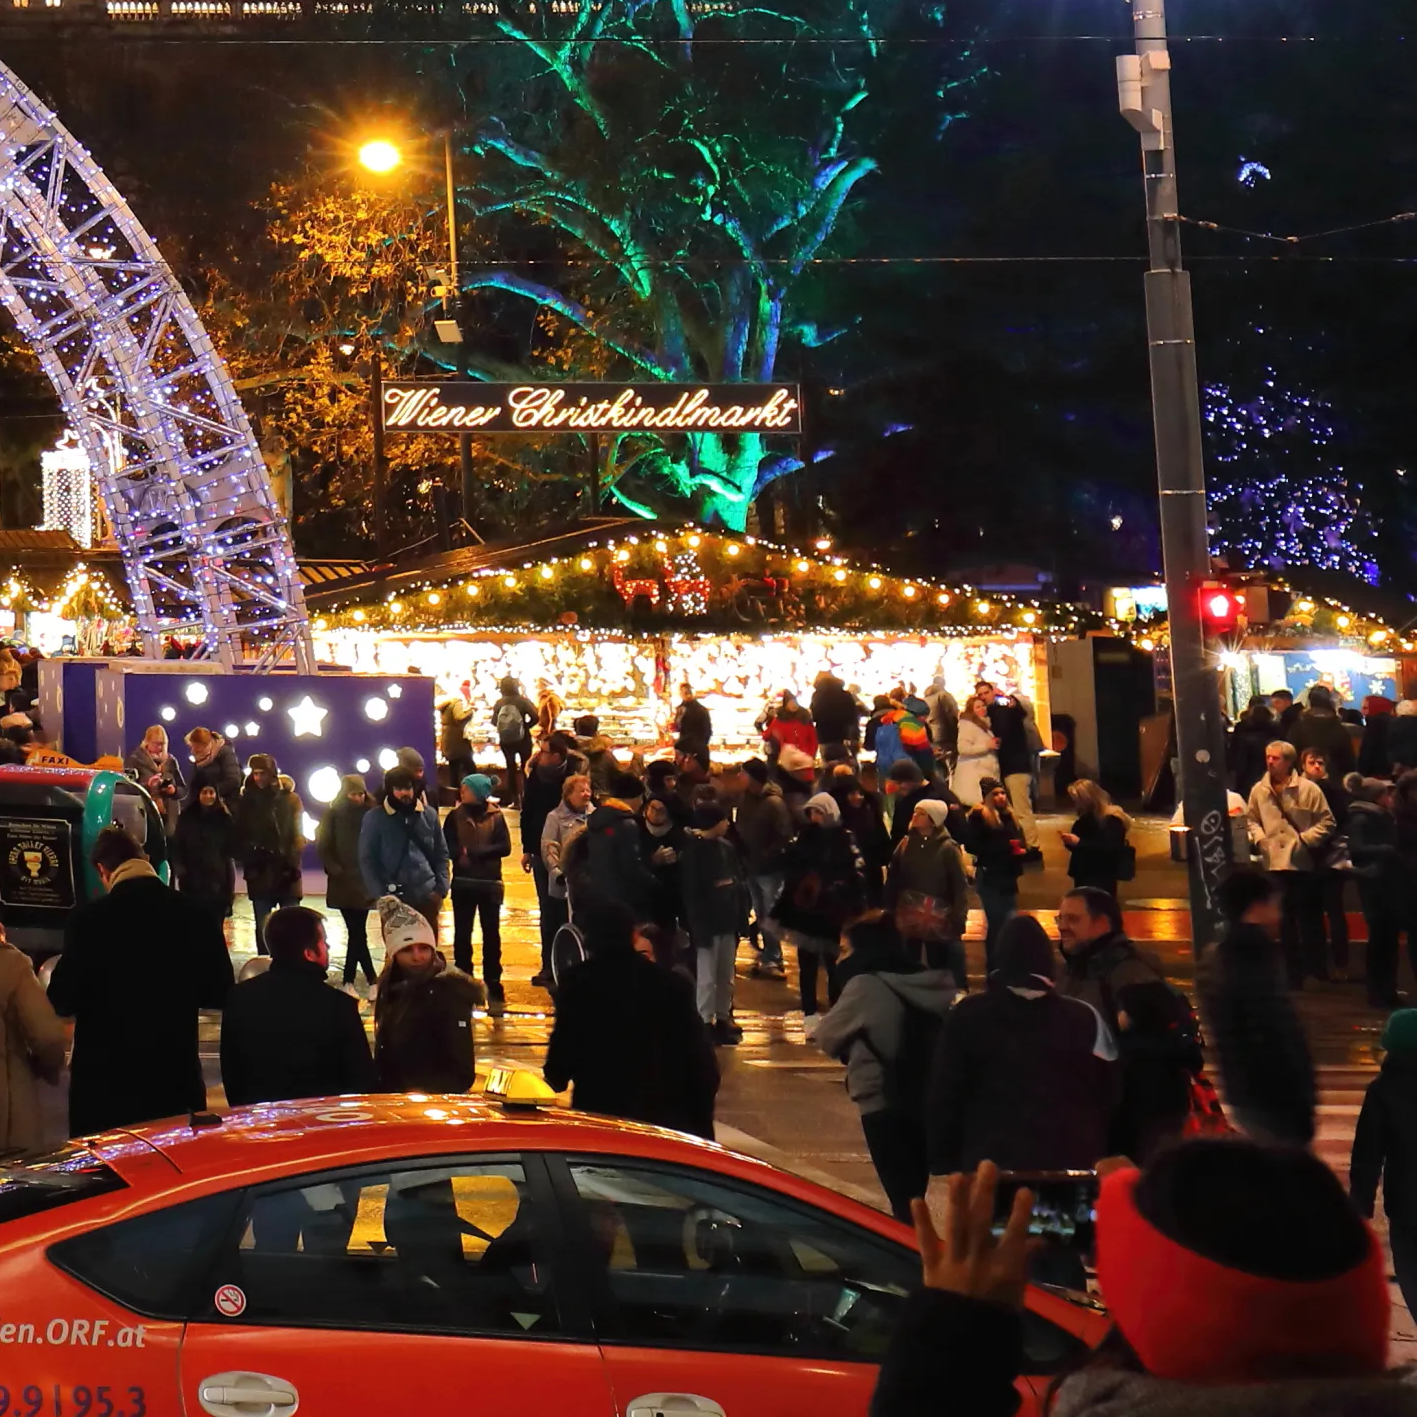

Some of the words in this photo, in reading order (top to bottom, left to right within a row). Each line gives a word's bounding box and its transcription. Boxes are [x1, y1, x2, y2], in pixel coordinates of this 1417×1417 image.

[384, 386, 502, 428] Wiener
[508, 385, 798, 428] Christkindlmarkt
[41, 755, 70, 765] FAXI
[72, 1385, 147, 1417] 95.3
